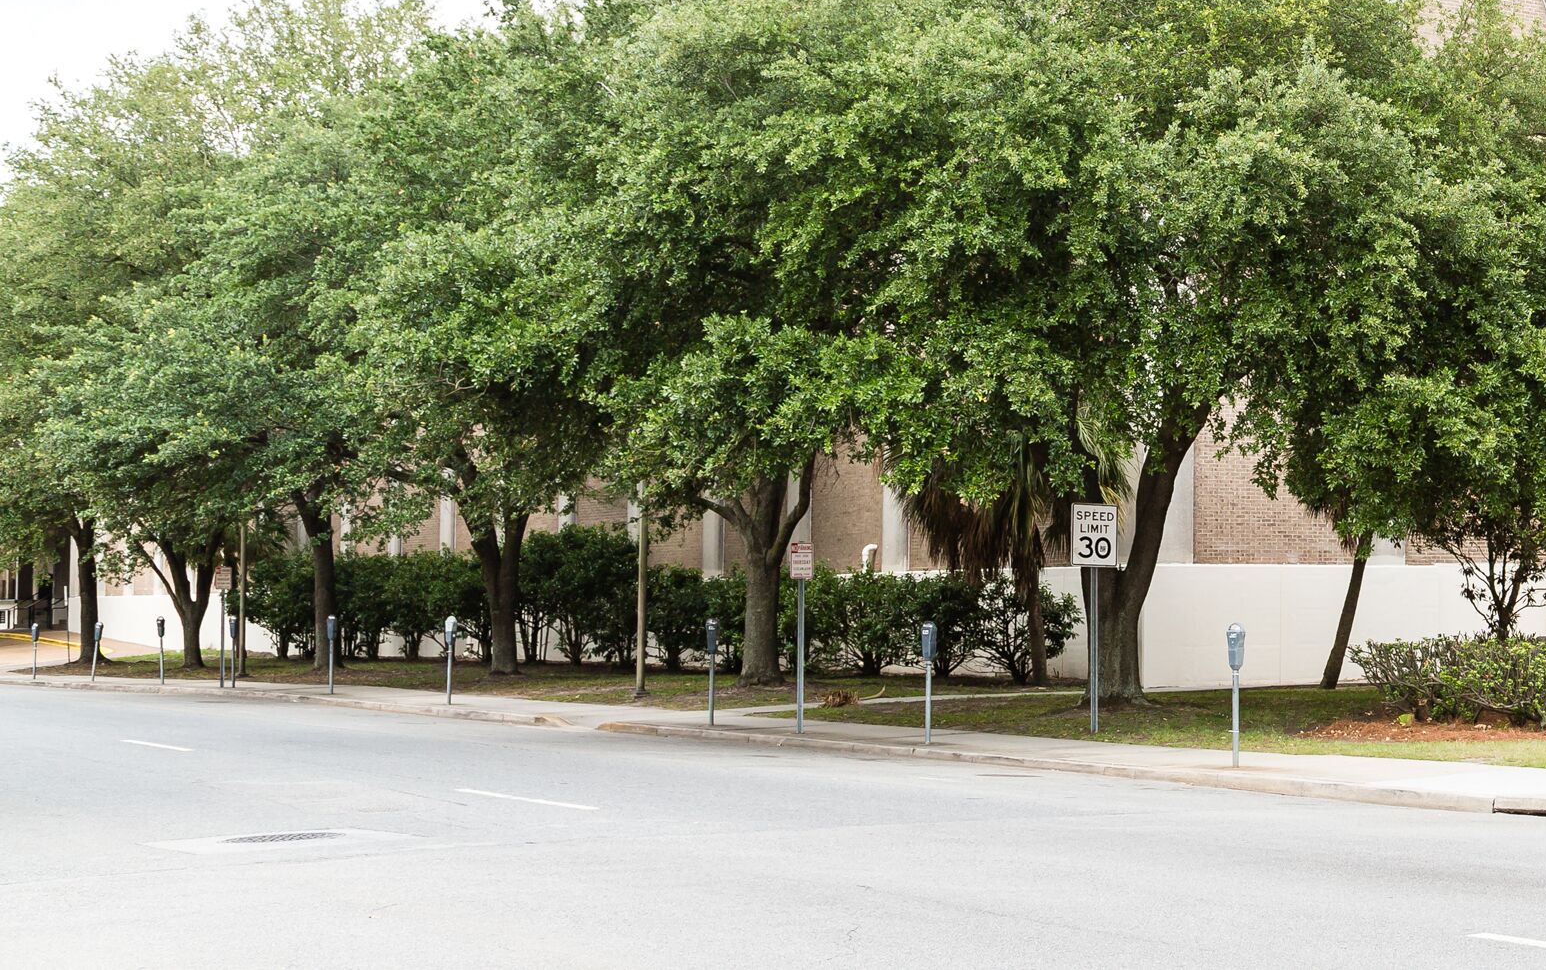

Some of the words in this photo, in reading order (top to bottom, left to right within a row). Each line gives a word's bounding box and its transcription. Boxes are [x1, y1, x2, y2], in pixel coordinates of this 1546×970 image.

[1076, 510, 1114, 521] SPEED
[1080, 523, 1109, 534] LIMIT
[1078, 536, 1112, 559] 30
